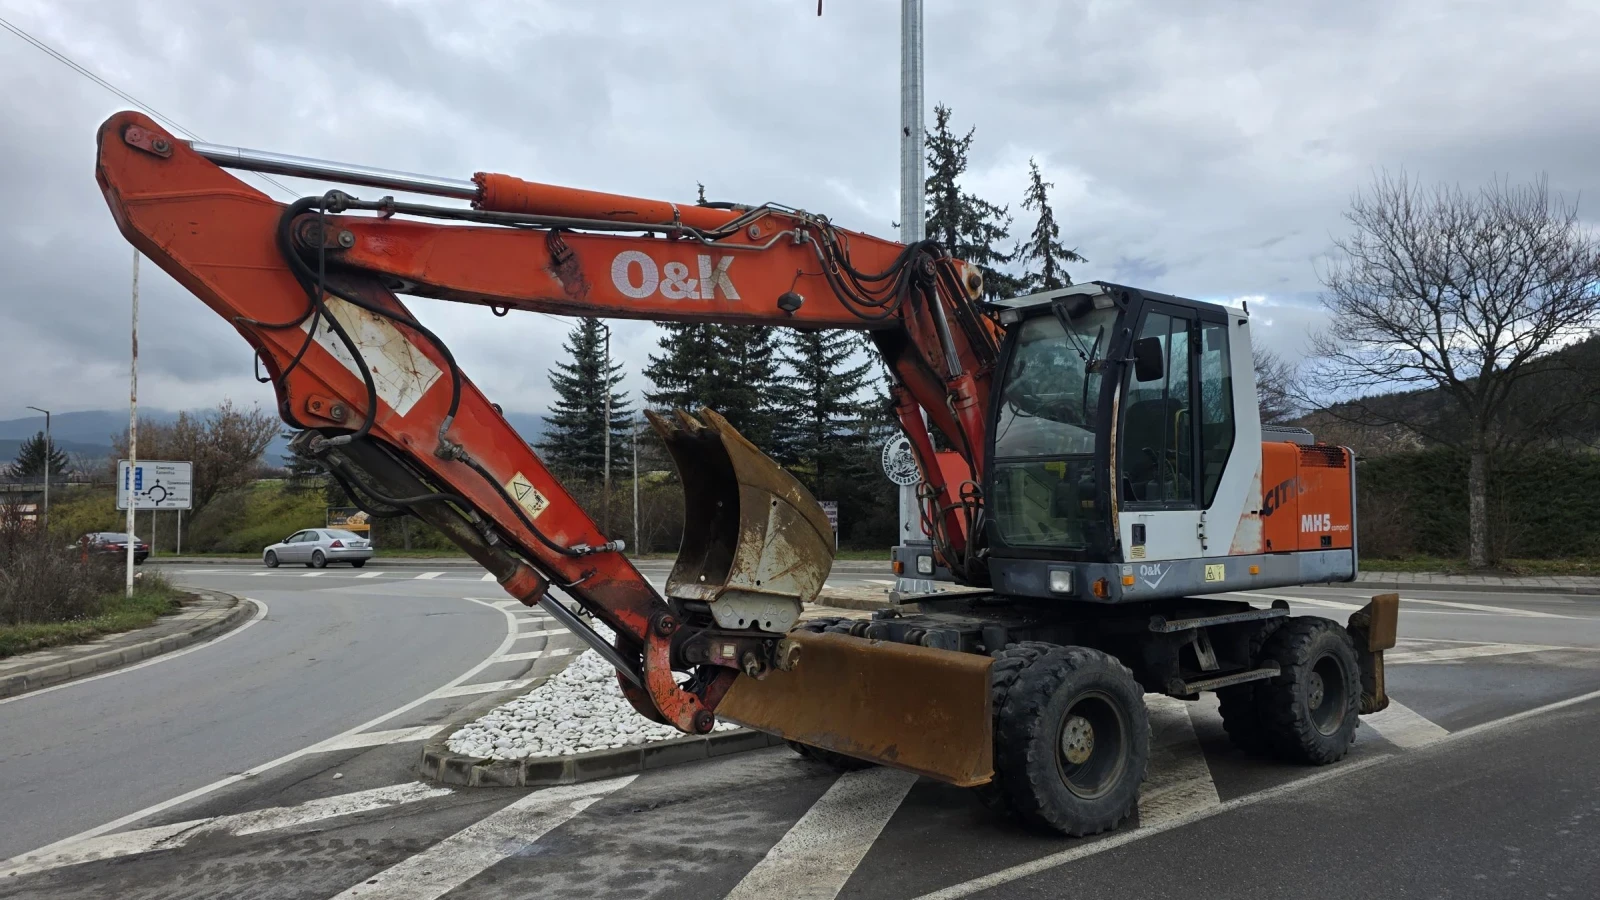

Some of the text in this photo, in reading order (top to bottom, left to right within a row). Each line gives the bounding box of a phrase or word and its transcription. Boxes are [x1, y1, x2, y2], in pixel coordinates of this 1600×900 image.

[611, 250, 741, 300] O&K
[1301, 514, 1331, 532] MH5
[1140, 563, 1162, 577] O&K
